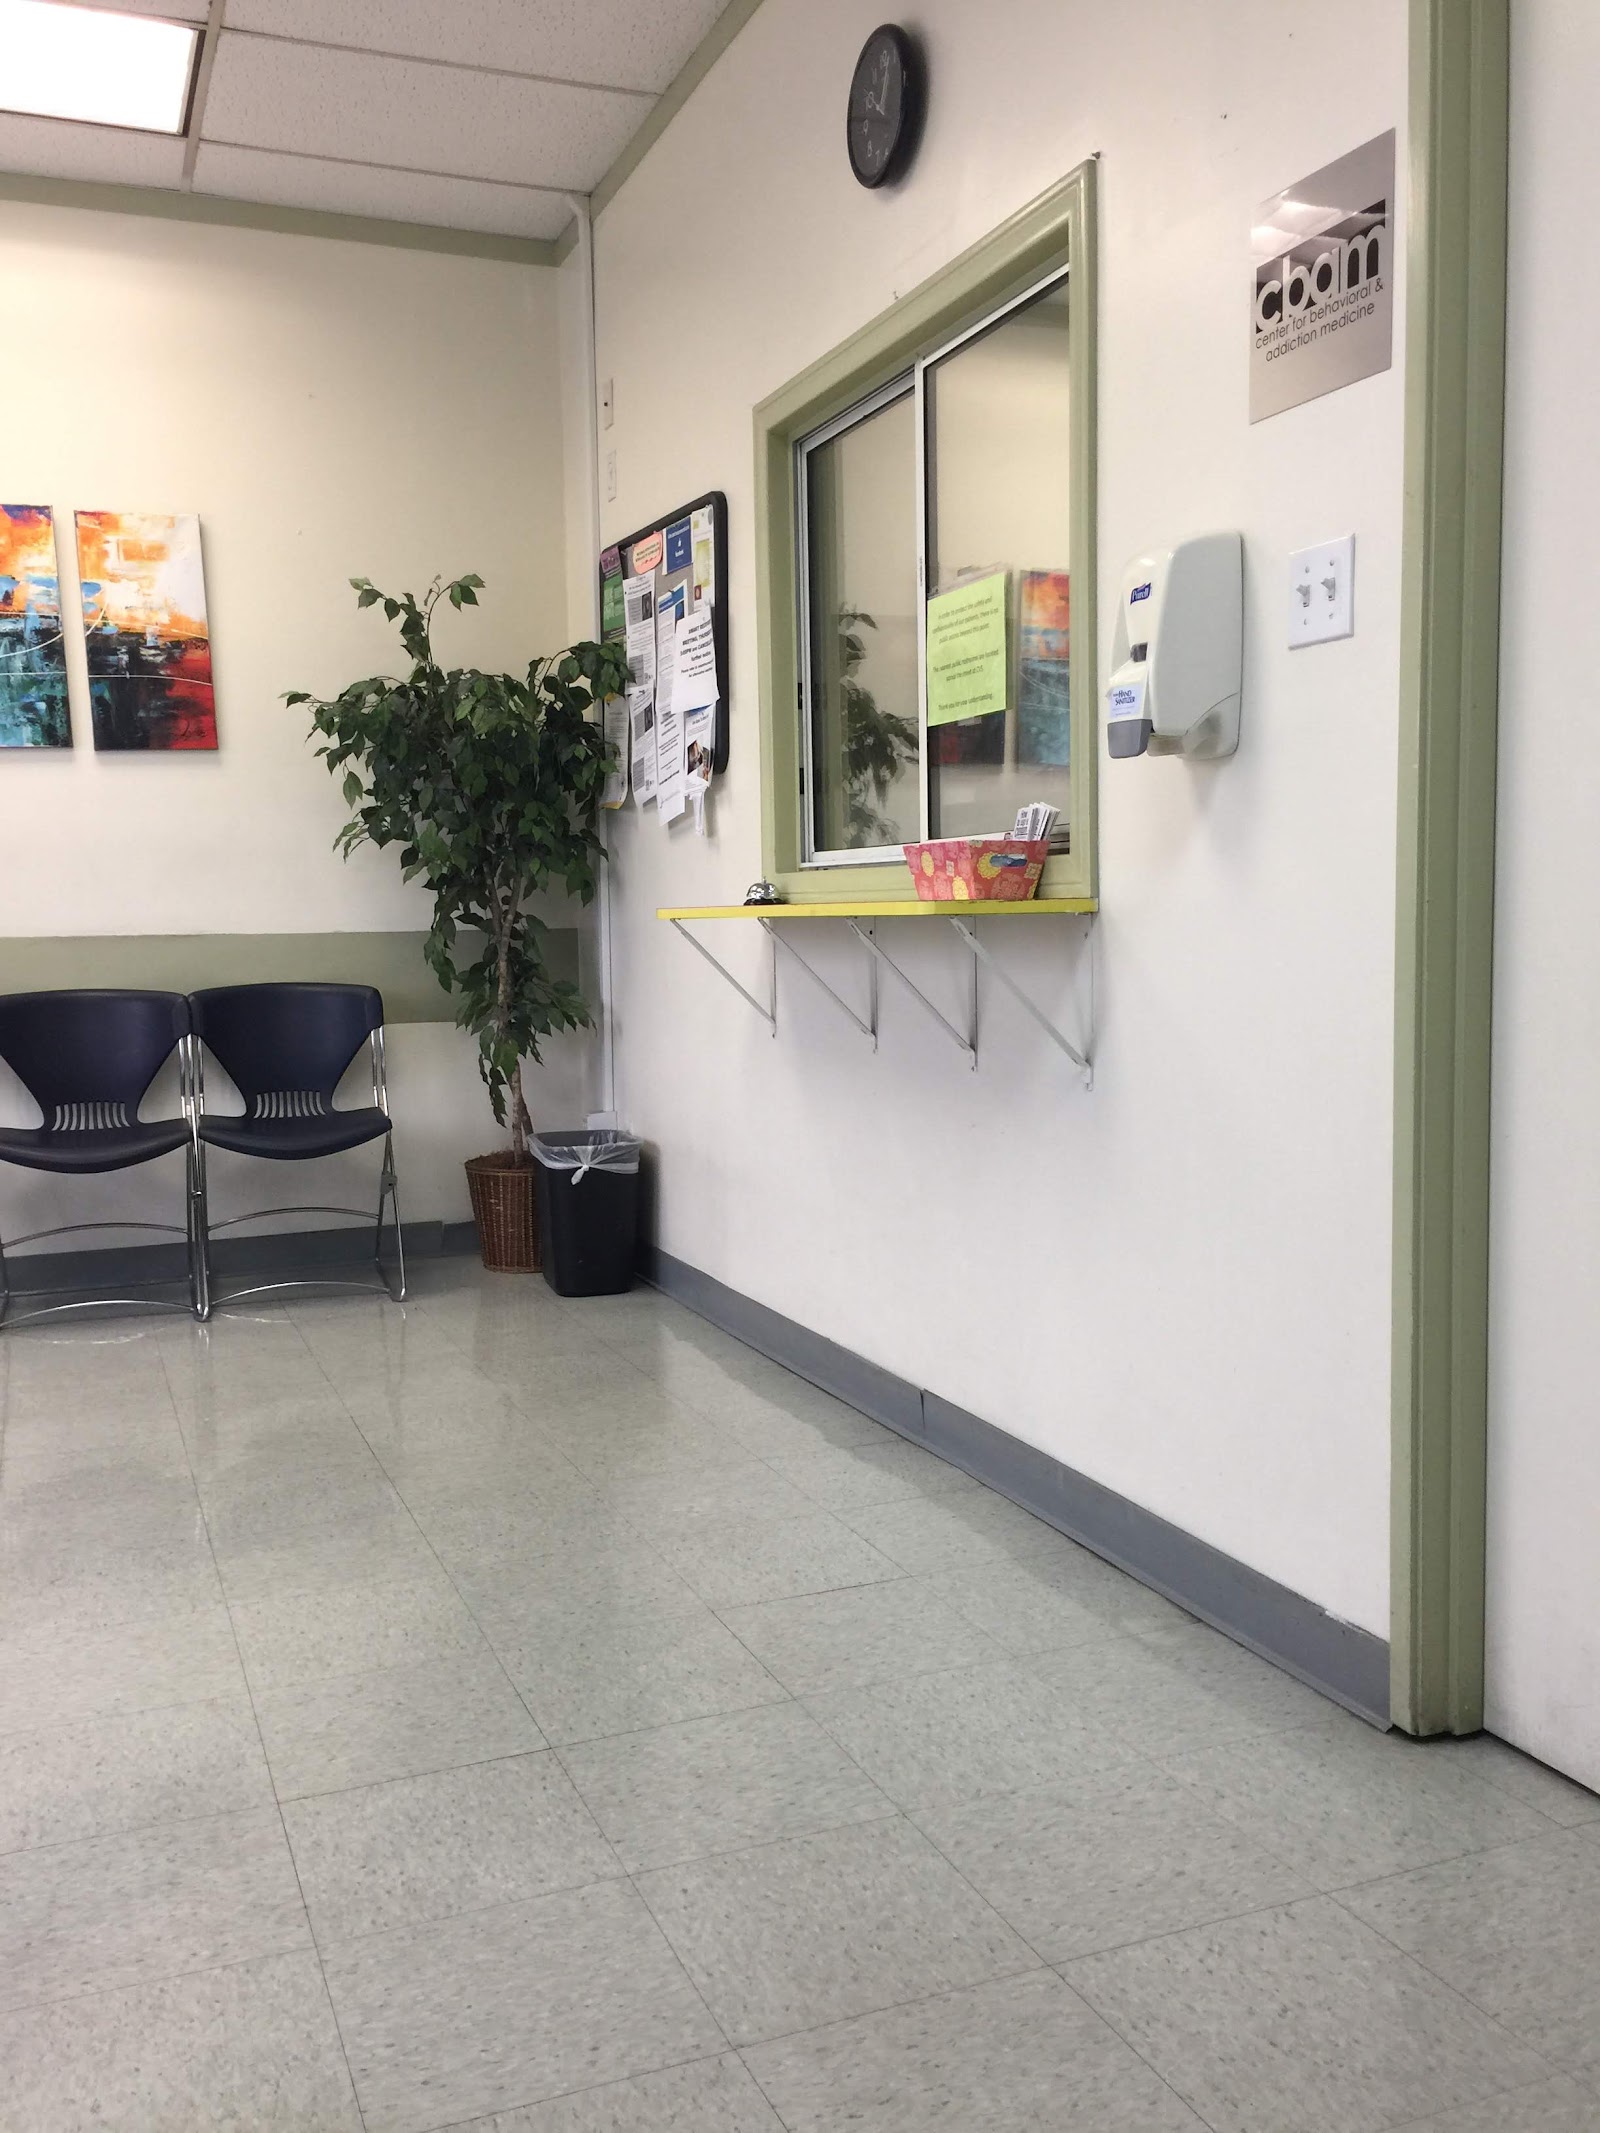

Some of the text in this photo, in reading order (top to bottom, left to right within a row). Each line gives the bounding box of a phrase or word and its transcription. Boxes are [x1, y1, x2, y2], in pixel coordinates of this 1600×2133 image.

[1255, 222, 1386, 333] cbam
[1256, 278, 1384, 349] center for behavioral &
[1266, 303, 1375, 362] addiction medicine
[1115, 696, 1135, 705] SANITIZER
[1118, 690, 1132, 698] HAND
